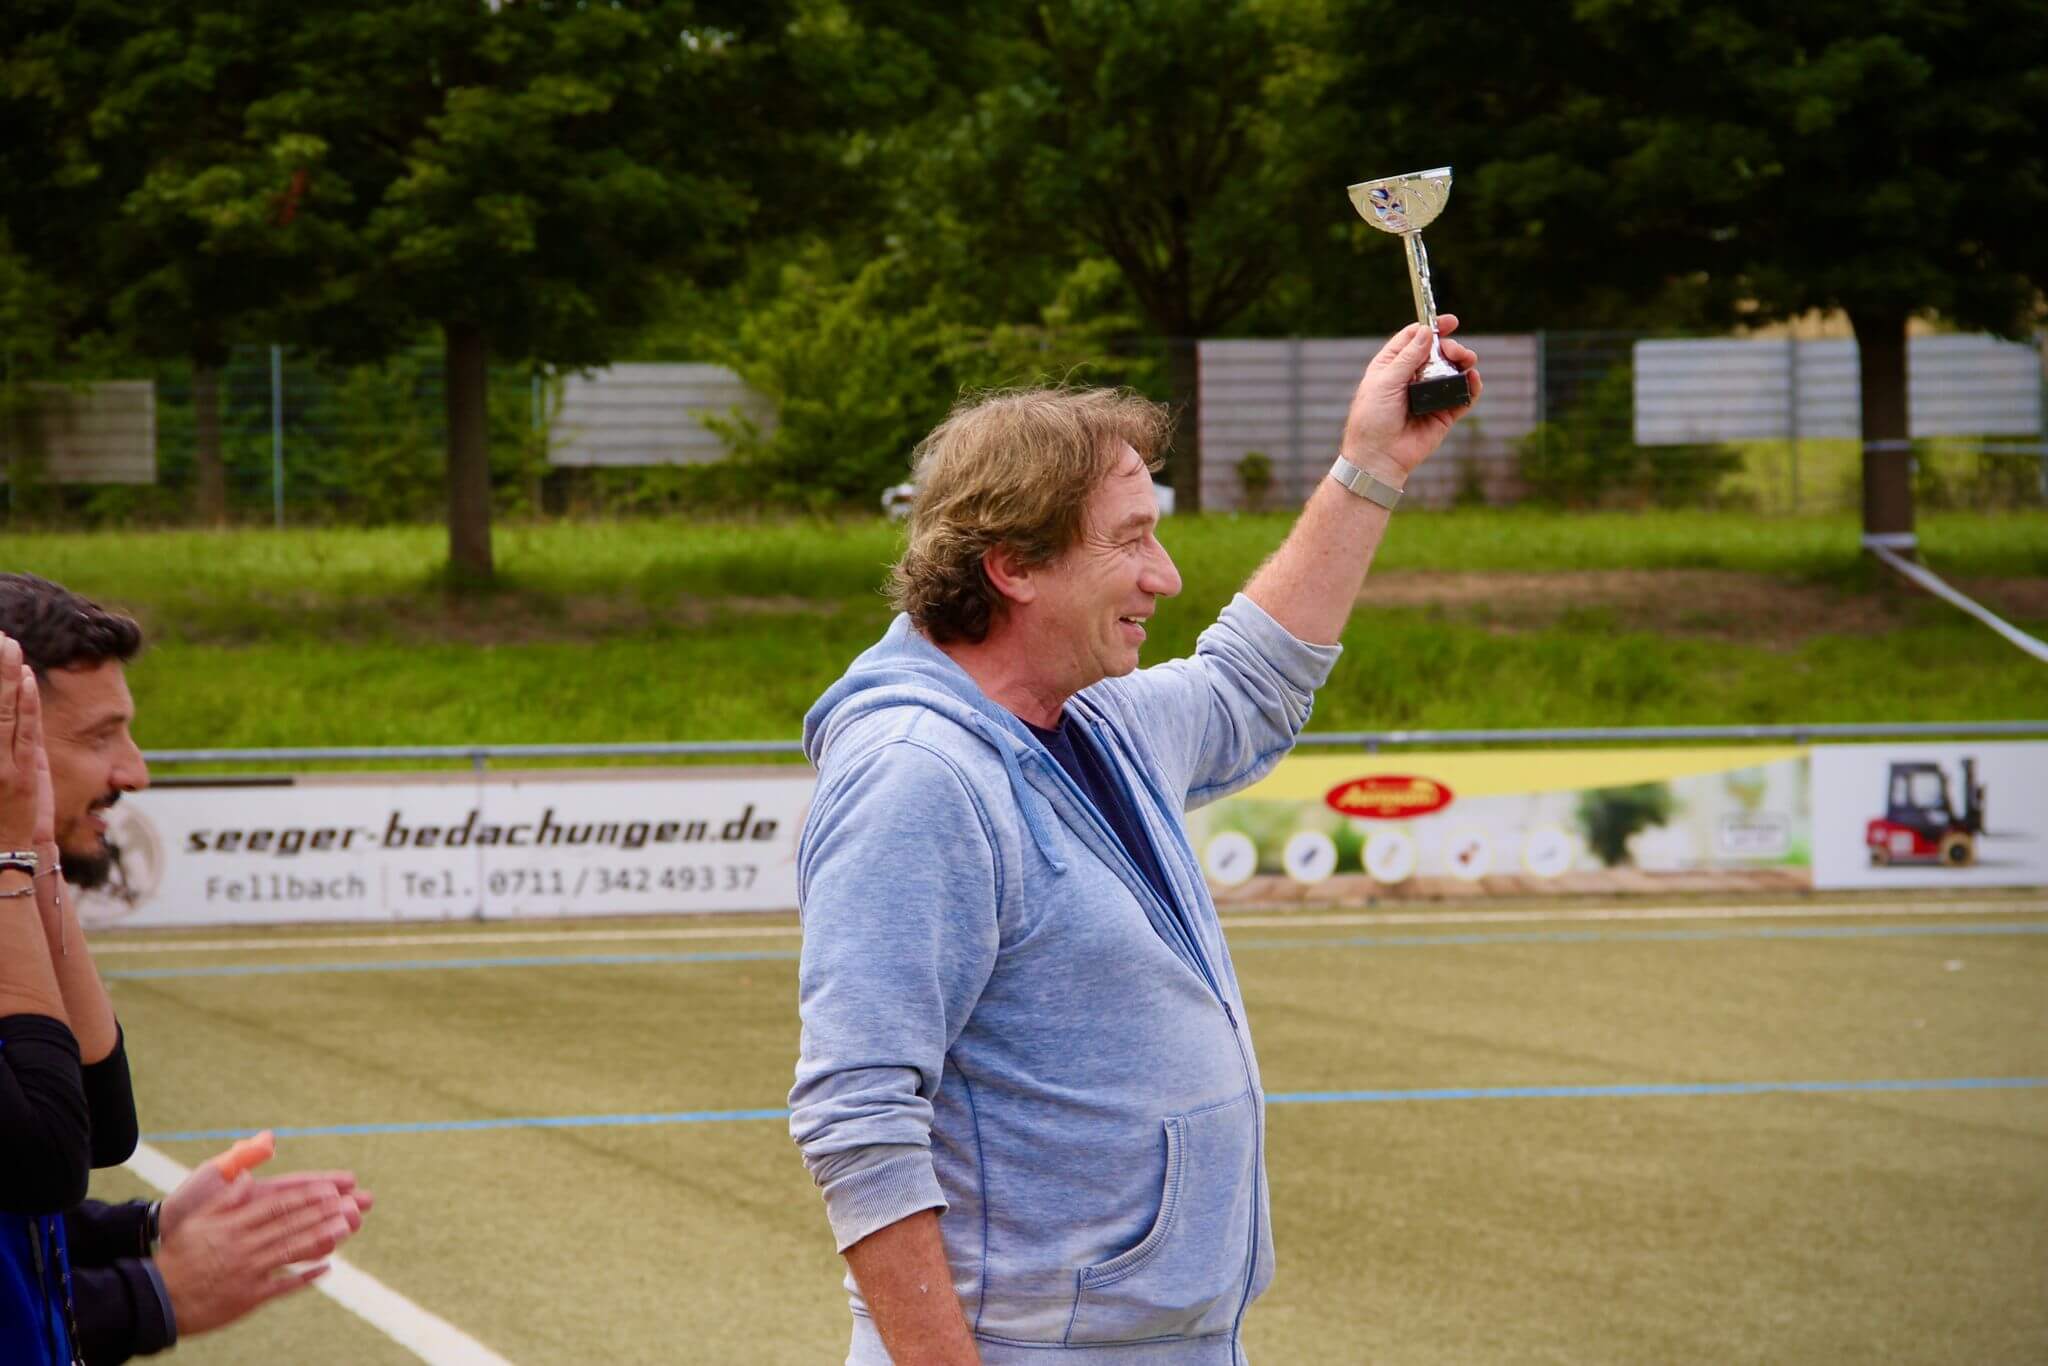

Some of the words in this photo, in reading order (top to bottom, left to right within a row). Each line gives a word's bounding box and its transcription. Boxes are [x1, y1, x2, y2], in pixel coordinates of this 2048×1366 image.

[186, 801, 779, 857] seeger-bedachungen.de
[204, 873, 367, 902] Fellbach
[402, 871, 473, 899] Tel.
